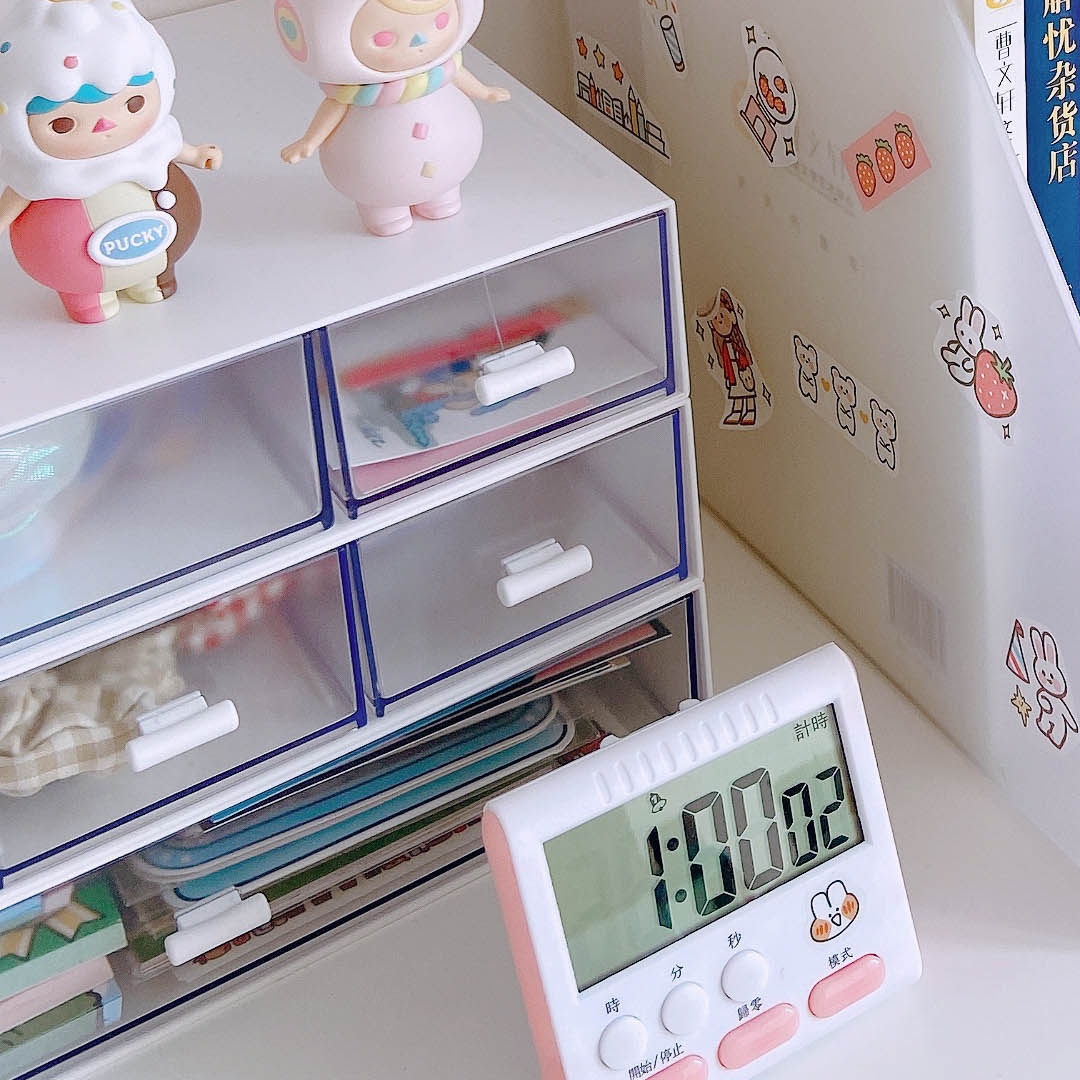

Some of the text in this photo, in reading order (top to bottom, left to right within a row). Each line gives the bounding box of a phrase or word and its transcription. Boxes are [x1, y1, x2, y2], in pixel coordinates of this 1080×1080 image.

[103, 224, 164, 255] PUCKY
[794, 711, 829, 742] 計時
[782, 766, 849, 867] 02
[727, 931, 742, 949] 秒
[828, 946, 854, 970] 模式
[671, 964, 684, 981] 分
[605, 997, 621, 1015] 時
